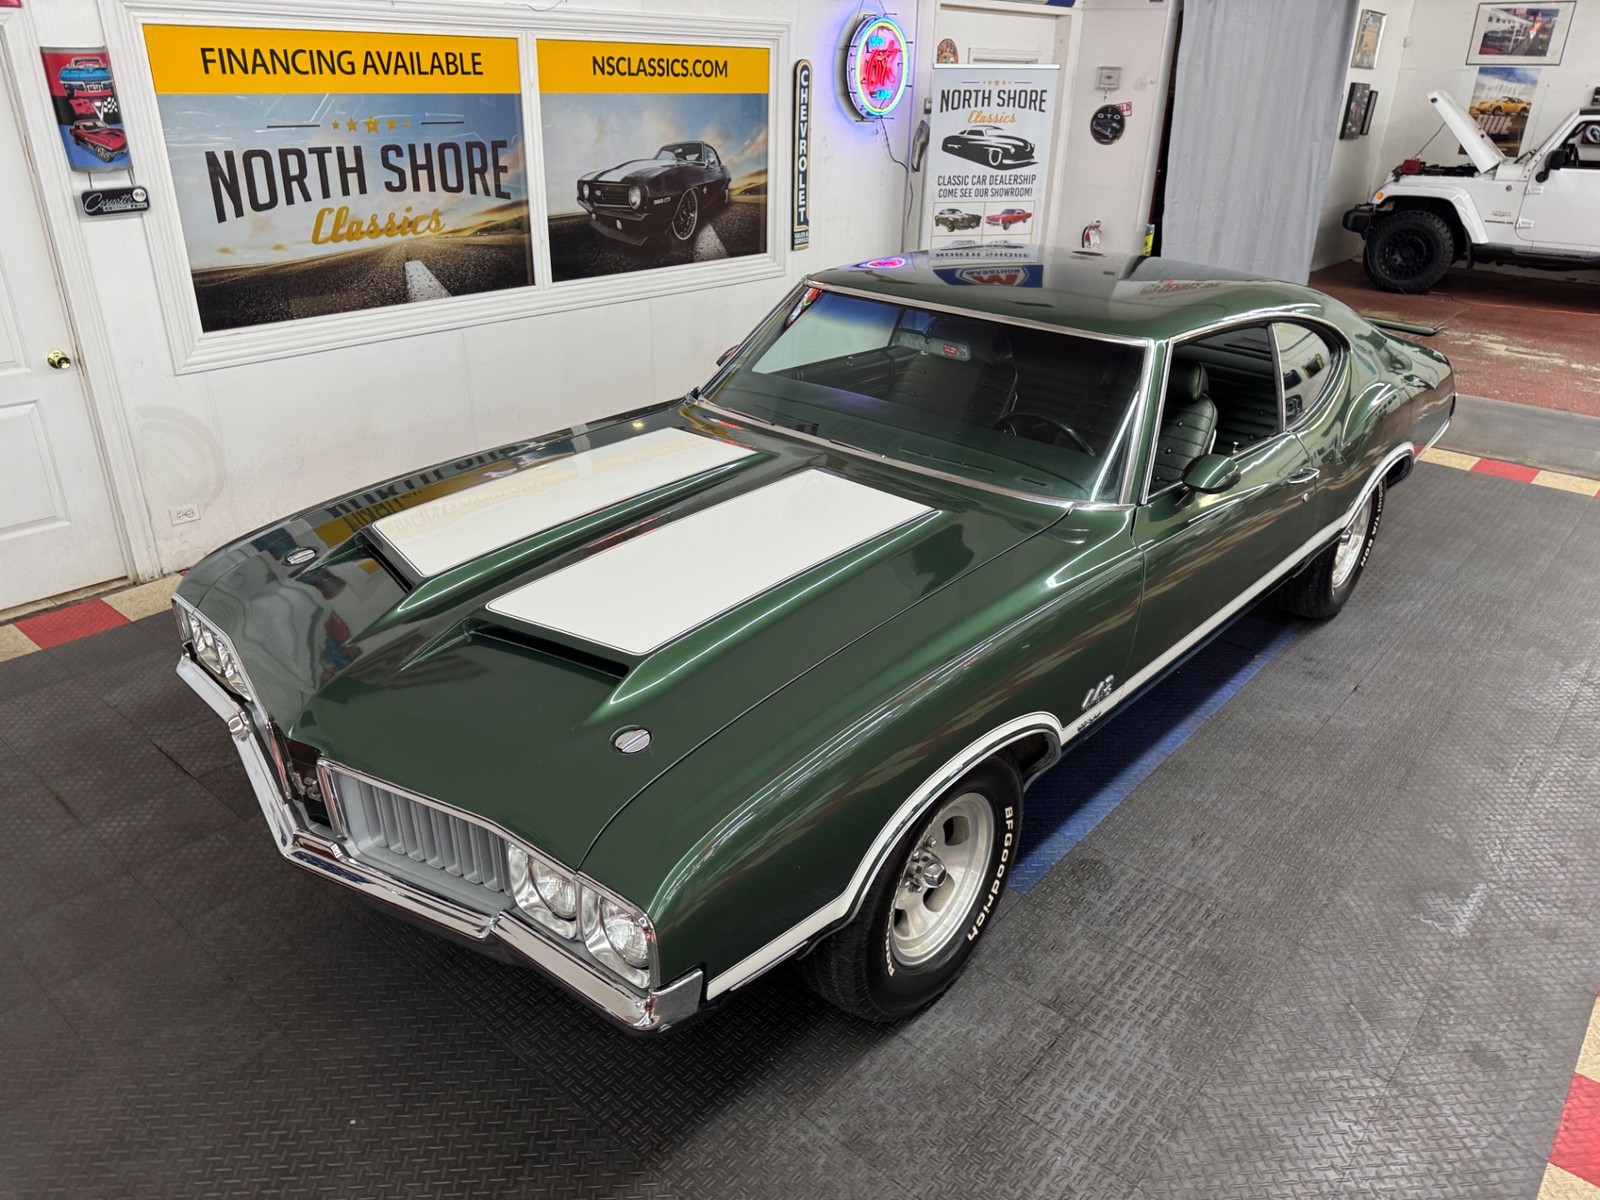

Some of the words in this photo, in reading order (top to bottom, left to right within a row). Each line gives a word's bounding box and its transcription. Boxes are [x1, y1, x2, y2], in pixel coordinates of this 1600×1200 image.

[200, 47, 356, 75] FINANCING
[362, 50, 484, 76] AVAILABLE
[592, 56, 728, 78] NSCLASSICS.COM
[940, 89, 992, 113] NORTH
[996, 89, 1048, 112] SHORE
[967, 110, 1017, 124] Classics
[798, 69, 809, 222] CHEVROLET
[205, 145, 368, 224] NORTH
[380, 139, 512, 200] SHORE
[937, 175, 970, 187] CLASSIC
[971, 175, 988, 186] CAR
[988, 174, 1037, 185] DEALERSHIP
[938, 188, 958, 198] COME
[960, 188, 973, 198] SEE
[974, 188, 989, 198] OUR
[990, 187, 1033, 197] SHOWROOM!
[311, 206, 446, 245] Classics
[966, 805, 1014, 942] BFGoodrich
